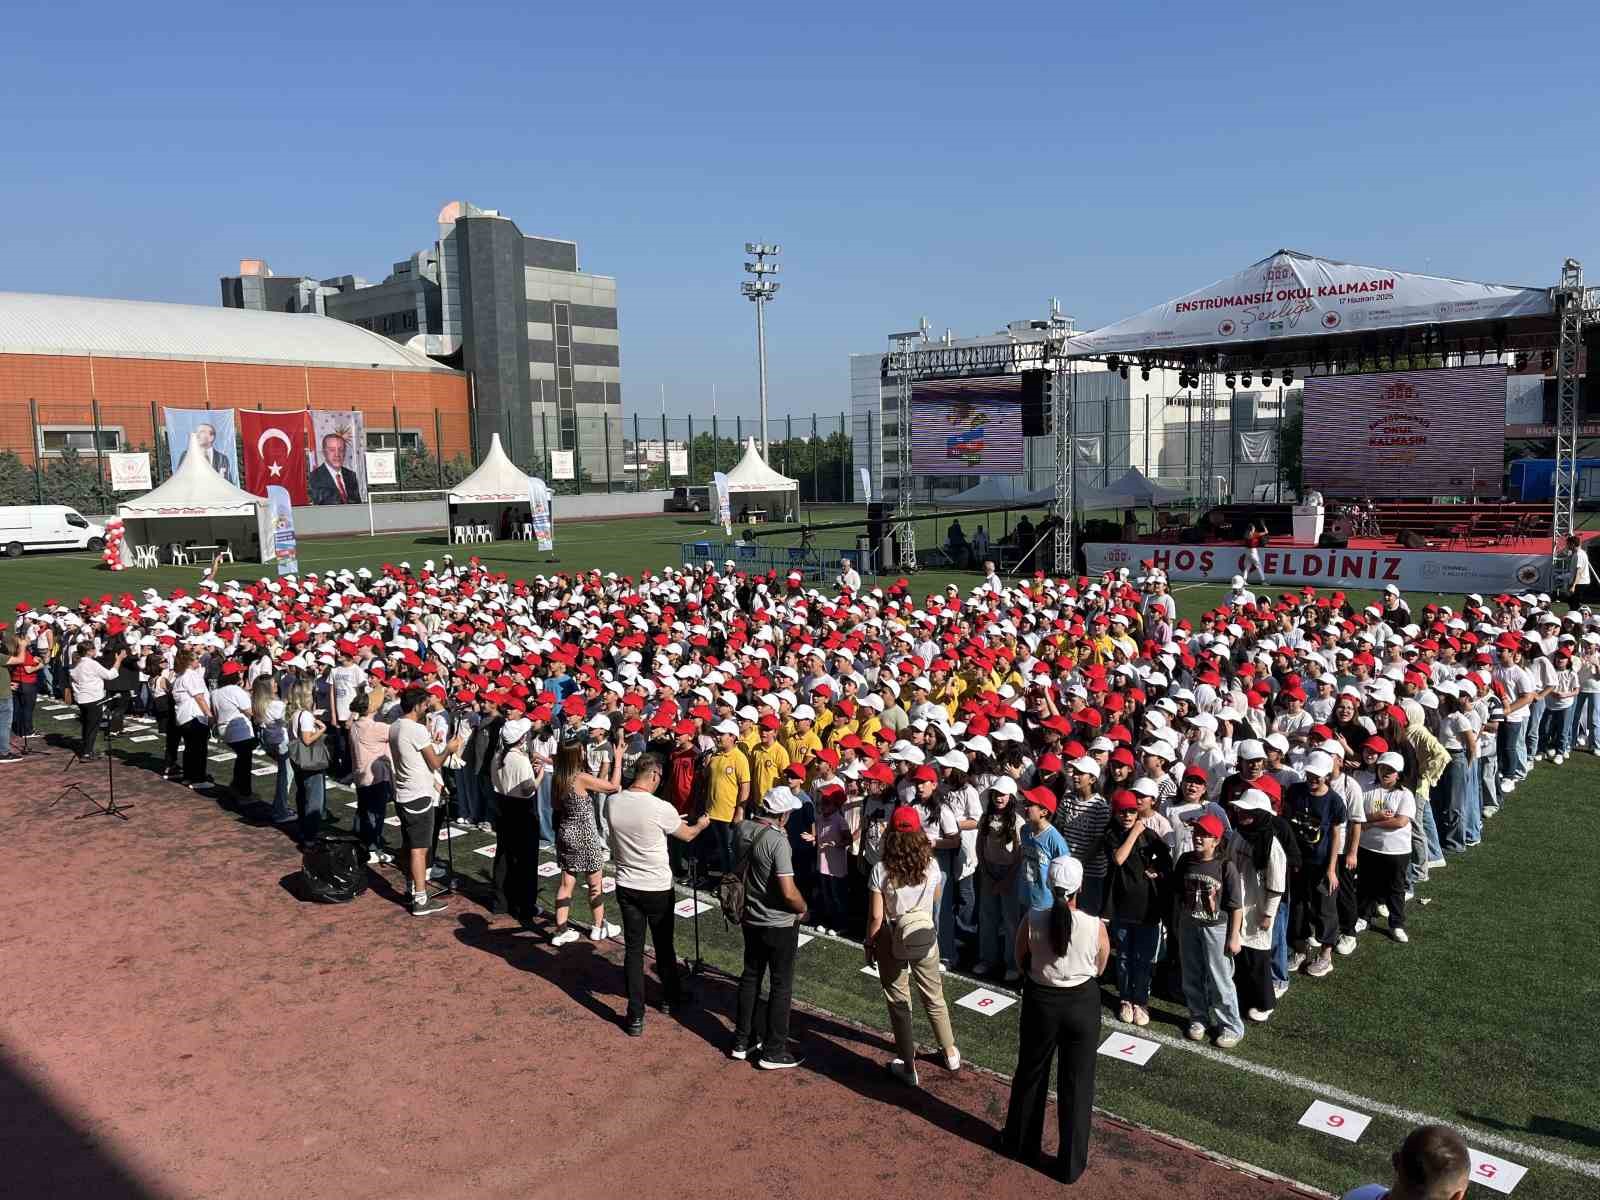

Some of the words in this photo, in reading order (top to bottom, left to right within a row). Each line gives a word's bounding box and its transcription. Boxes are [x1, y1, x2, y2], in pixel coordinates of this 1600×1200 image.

[1175, 291, 1274, 313] ENSTRÜMANSIZ
[1276, 287, 1313, 302] OKUL
[1318, 279, 1395, 297] KALMASIN
[1153, 549, 1214, 577] HOŞ
[977, 998, 994, 1007] 8
[1119, 1044, 1136, 1055] 7
[1475, 1164, 1497, 1178] 5
